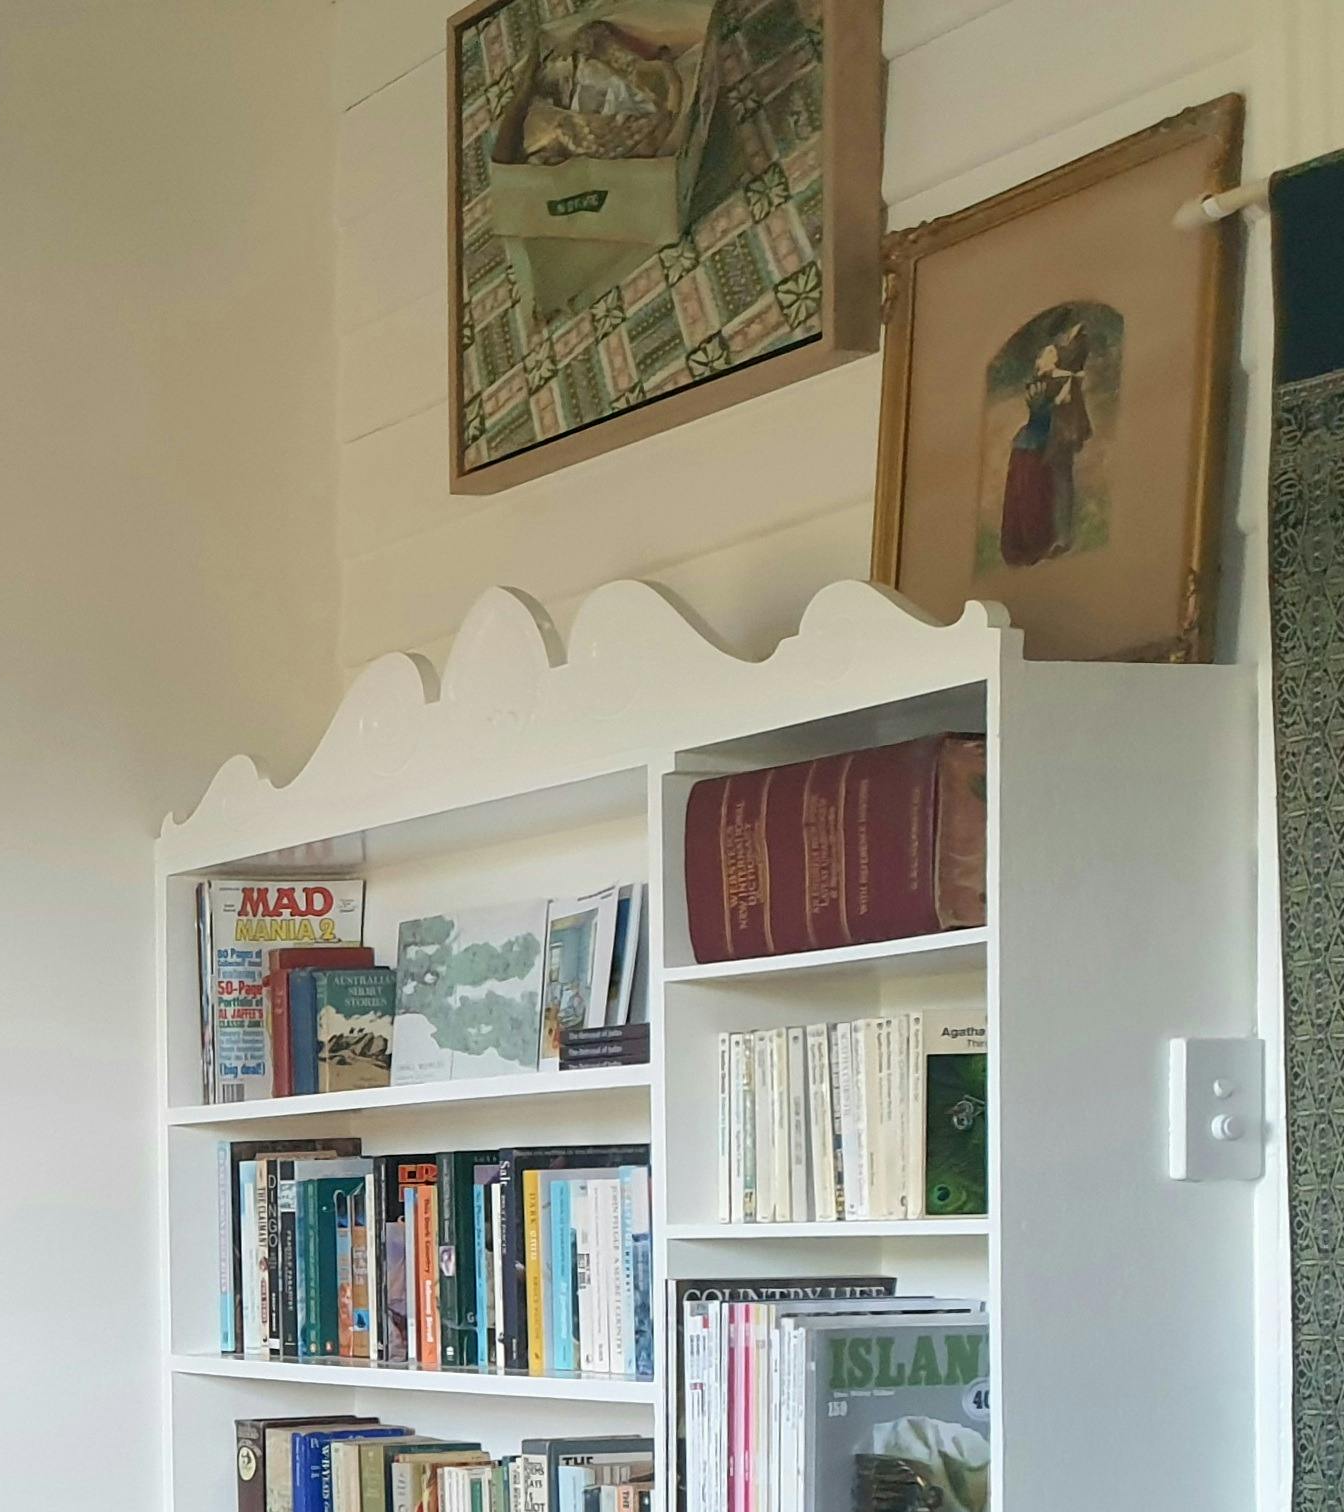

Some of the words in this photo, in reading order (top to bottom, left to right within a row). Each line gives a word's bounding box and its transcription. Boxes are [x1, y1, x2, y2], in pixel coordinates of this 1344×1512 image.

[238, 887, 334, 917] MAD
[235, 918, 317, 942] MANIA
[319, 918, 337, 941] 2
[217, 981, 263, 997] 50-Page
[346, 999, 387, 1007] STORIES
[941, 1027, 985, 1039] Agatha
[499, 1160, 511, 1186] Salt
[257, 1187, 266, 1202] THE
[267, 1175, 278, 1248] DINGO
[257, 1206, 266, 1249] CLAIMANT
[424, 1217, 432, 1237] Dark
[424, 1241, 432, 1274] Country
[683, 1288, 822, 1301] COUNTRY
[828, 1286, 886, 1300] LIFE
[829, 1334, 989, 1389] ISLAN
[622, 1491, 630, 1509] THE
